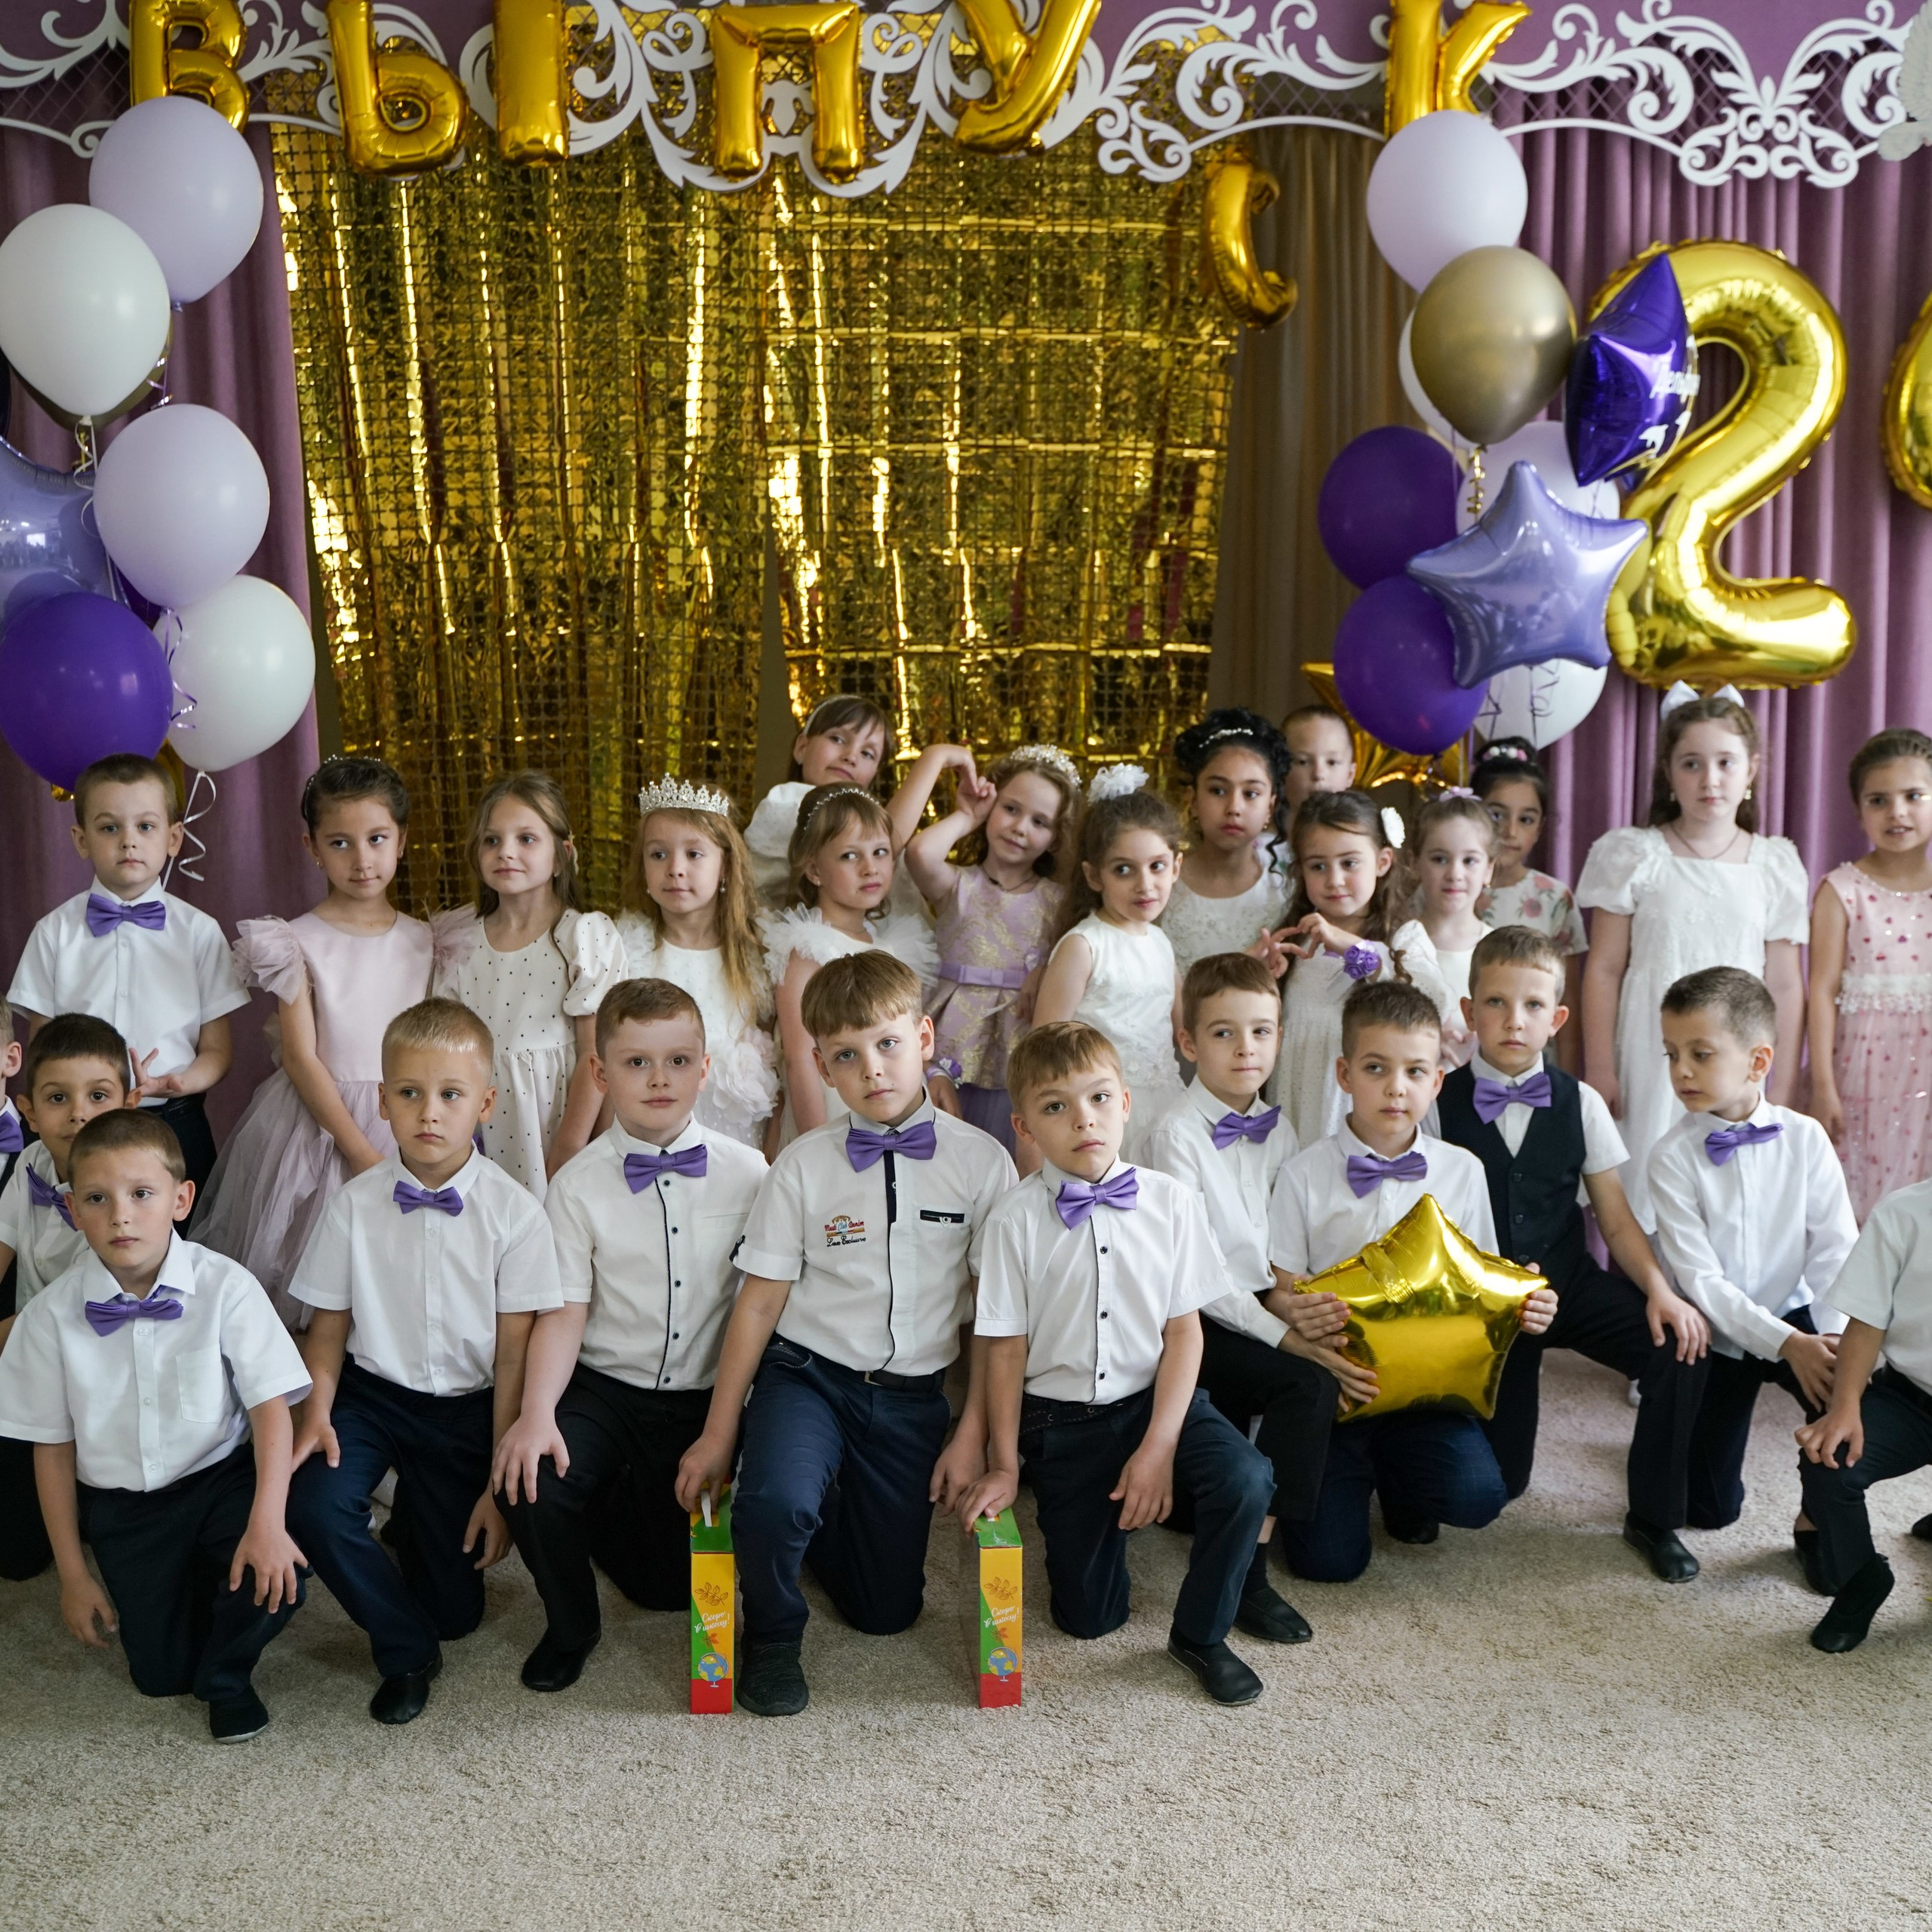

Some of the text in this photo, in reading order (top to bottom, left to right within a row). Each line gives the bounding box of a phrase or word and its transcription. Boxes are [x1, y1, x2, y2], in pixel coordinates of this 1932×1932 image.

[1586, 238, 1932, 691] 2
[702, 1611, 726, 1623] Скоро
[991, 1606, 1016, 1617] Скоро
